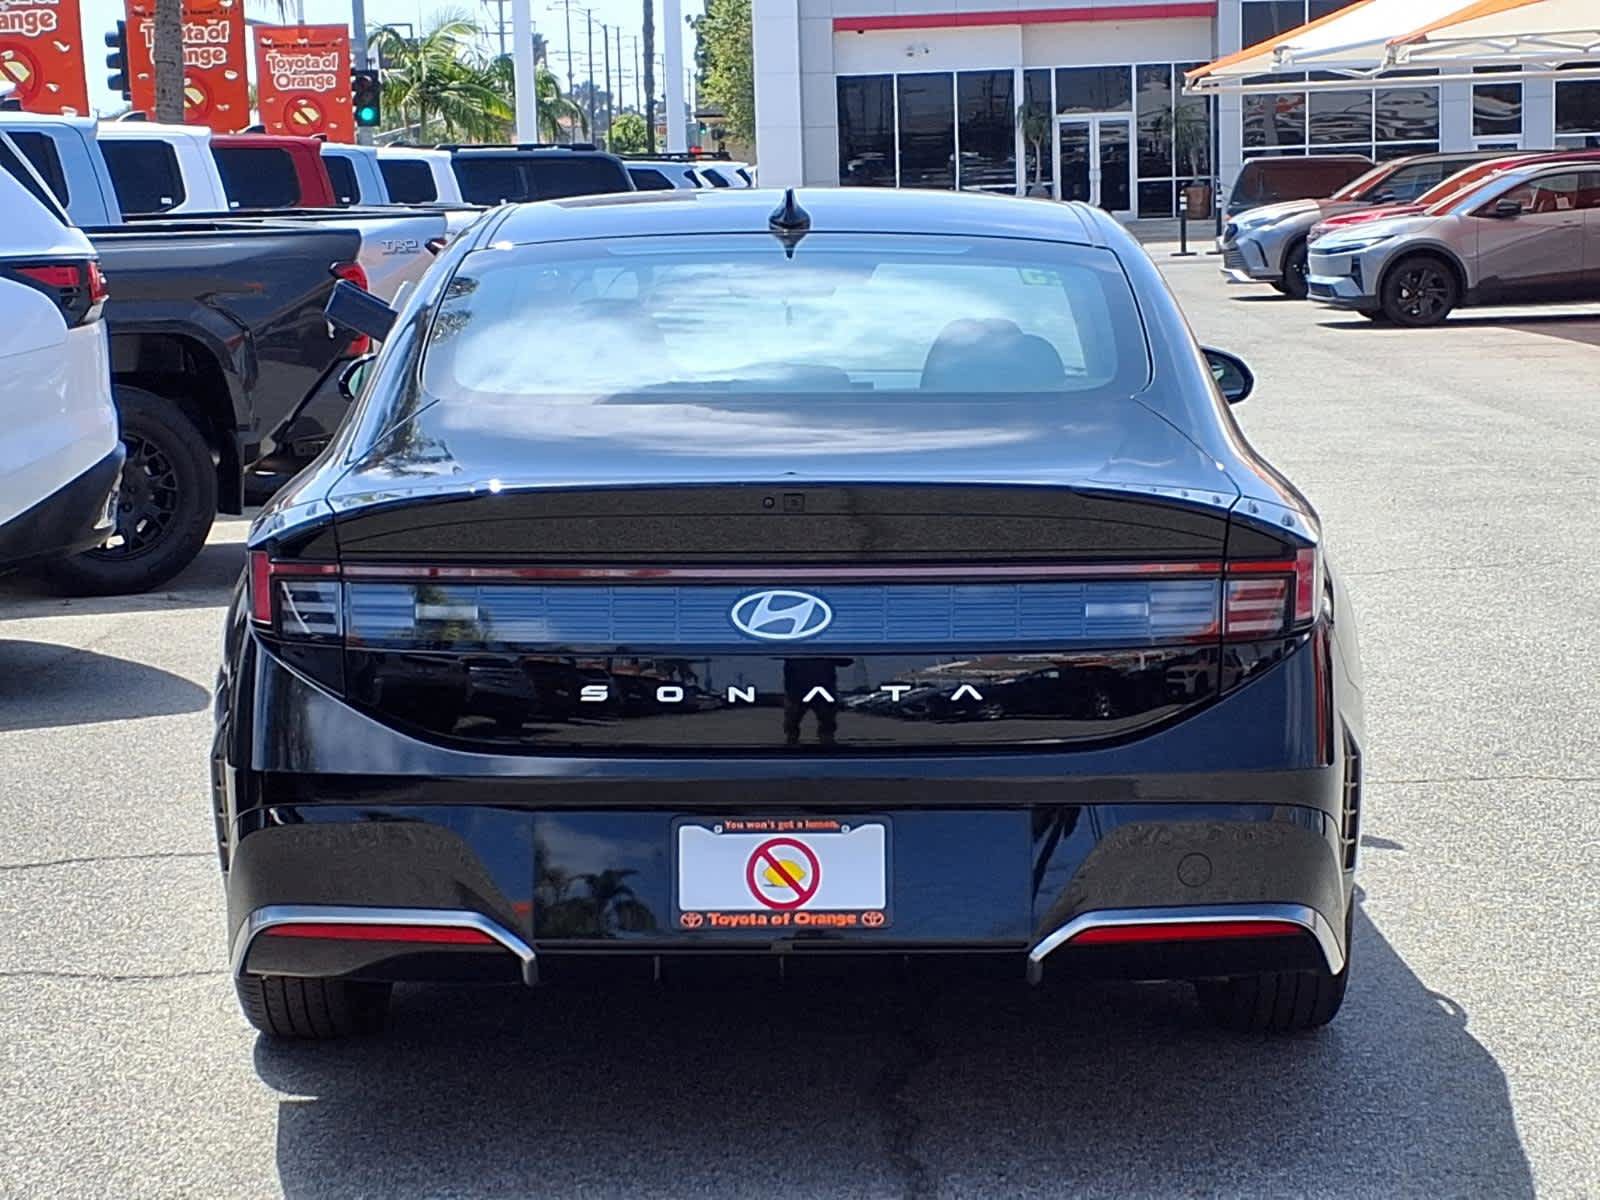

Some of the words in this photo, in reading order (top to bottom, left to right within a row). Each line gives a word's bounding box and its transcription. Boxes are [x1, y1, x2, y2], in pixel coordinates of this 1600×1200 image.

[140, 21, 208, 48] Tta
[207, 20, 230, 43] of
[149, 46, 227, 69] nge
[265, 53, 321, 74] Toyota
[273, 72, 337, 92] Orange
[580, 684, 983, 703] SONATA
[724, 820, 744, 830] You
[746, 819, 775, 830] won't
[707, 912, 767, 927] Toyota
[770, 912, 791, 926] of
[794, 912, 857, 926] Orange
